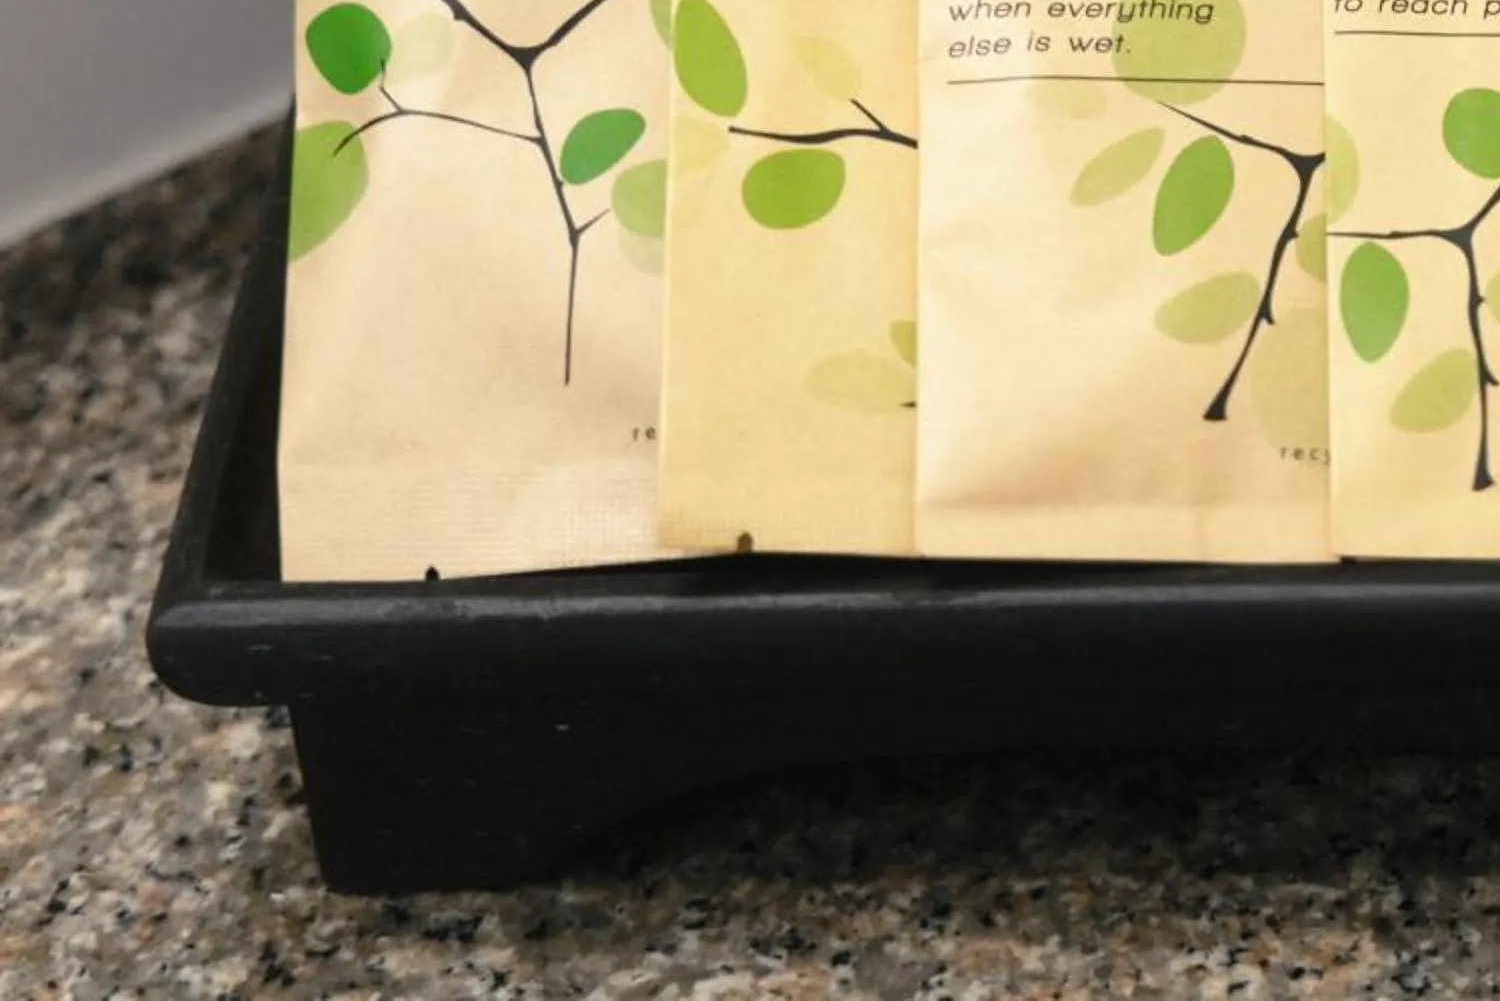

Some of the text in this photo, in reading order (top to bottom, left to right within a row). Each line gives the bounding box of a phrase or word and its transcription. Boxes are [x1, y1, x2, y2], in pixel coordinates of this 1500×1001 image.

[949, 0, 1031, 21] when
[948, 32, 1132, 58] else is wet.
